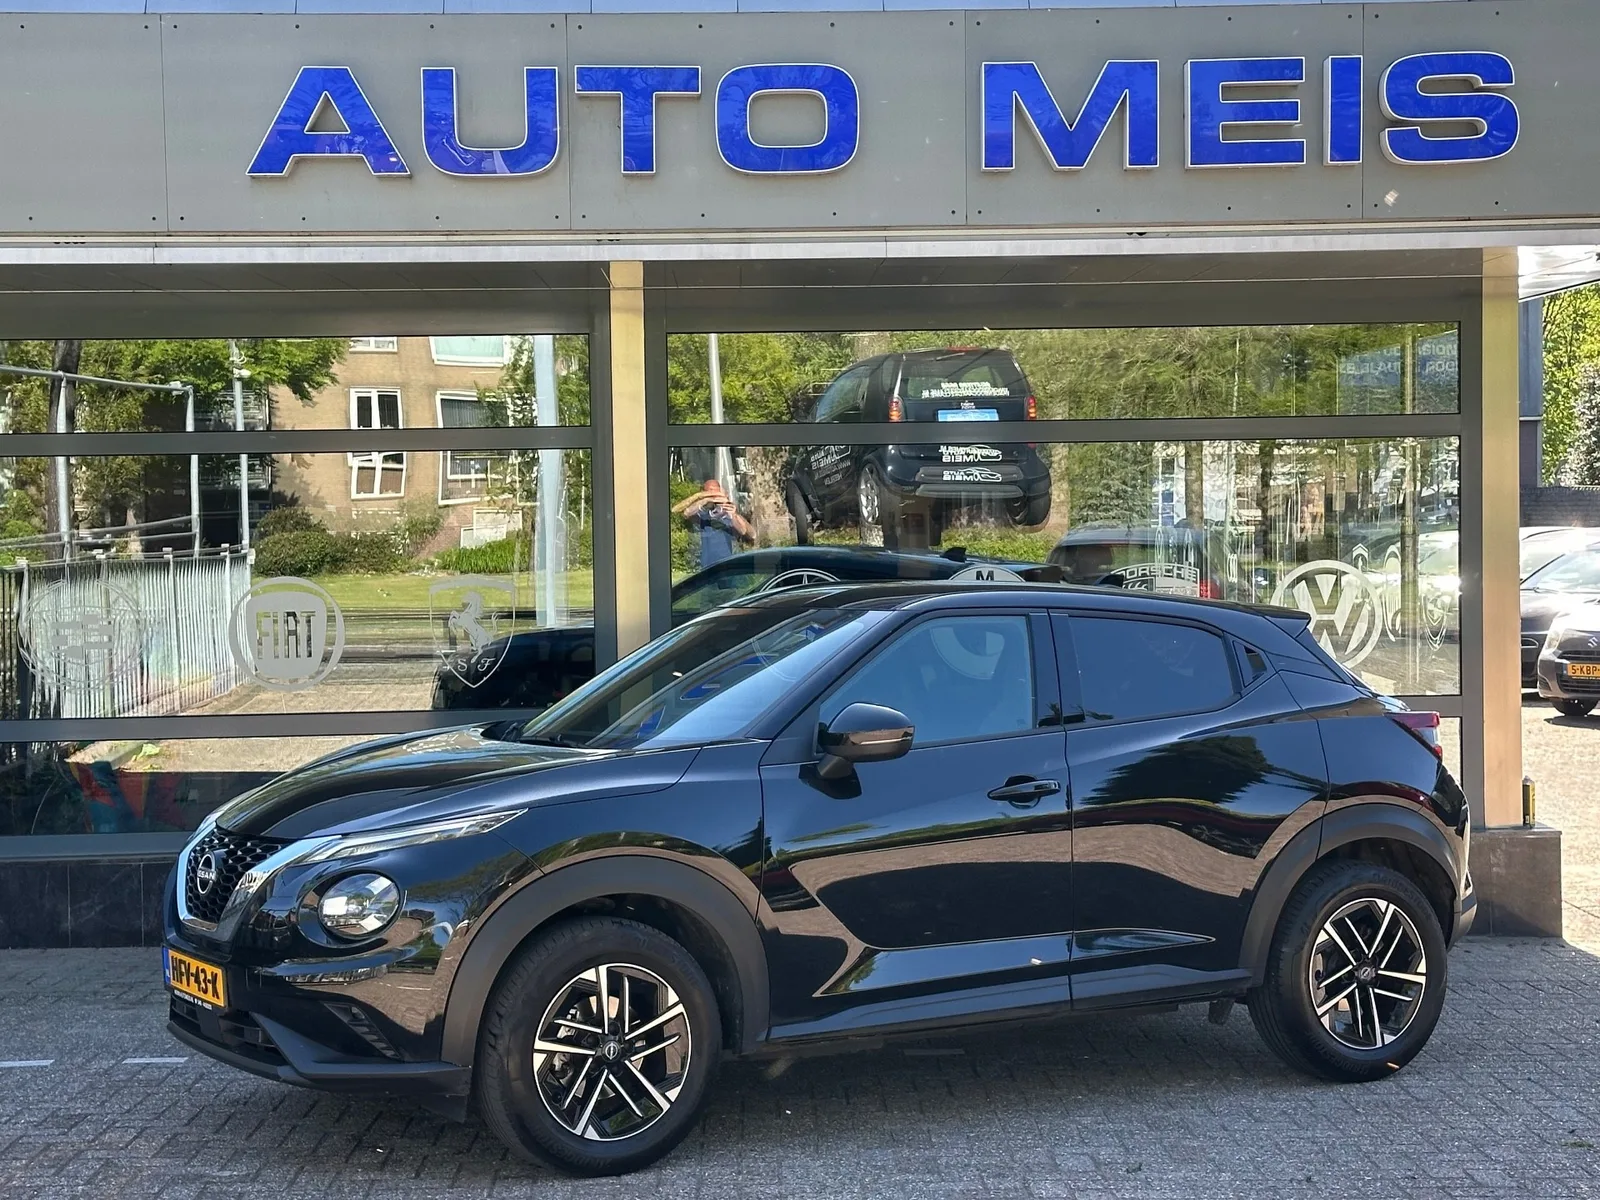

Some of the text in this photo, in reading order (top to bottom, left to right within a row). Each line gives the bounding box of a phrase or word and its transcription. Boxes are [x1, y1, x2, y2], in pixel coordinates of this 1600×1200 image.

[246, 50, 1522, 178] AUTO MEIS
[256, 610, 316, 660] FIAT
[457, 658, 468, 672] S
[170, 955, 221, 1000] HFV-43-K
